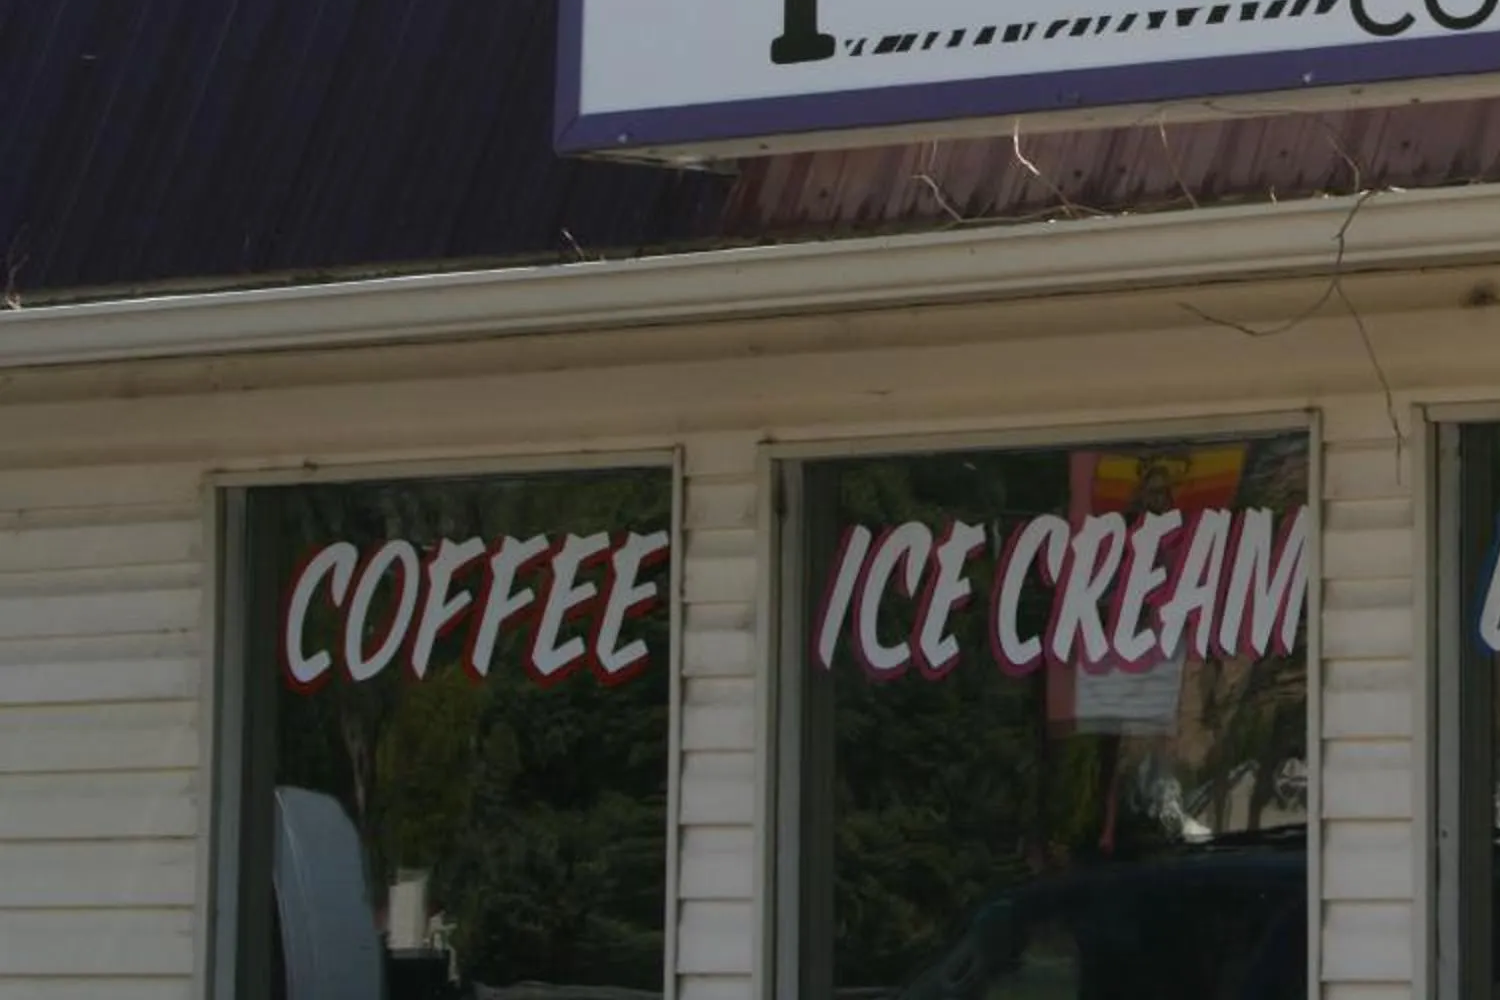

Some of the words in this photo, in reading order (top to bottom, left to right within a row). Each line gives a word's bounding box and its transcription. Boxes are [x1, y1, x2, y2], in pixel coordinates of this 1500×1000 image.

[277, 529, 669, 694] COFFEE
[812, 519, 987, 680] ICE
[990, 505, 1310, 677] CREAM
